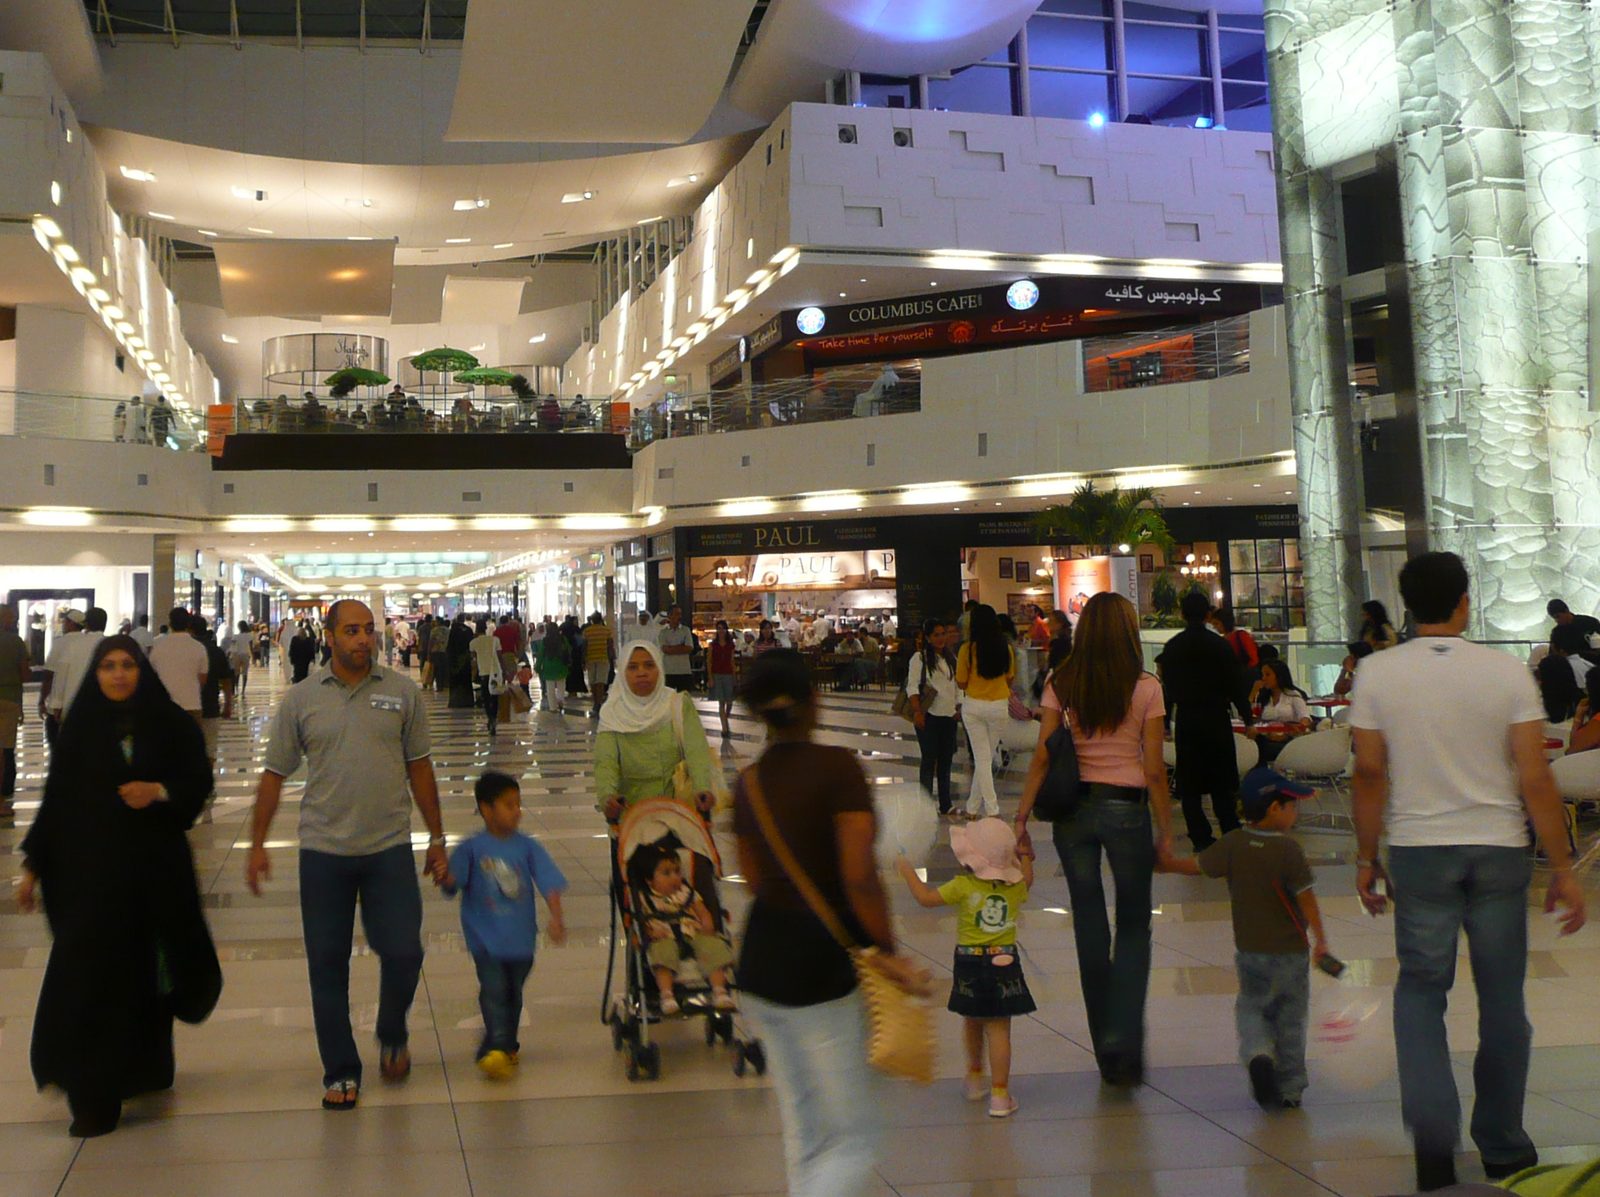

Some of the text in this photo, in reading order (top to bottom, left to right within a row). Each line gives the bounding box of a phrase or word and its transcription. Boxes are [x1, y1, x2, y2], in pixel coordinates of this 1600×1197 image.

[1105, 285, 1222, 305] كولومبوس كافيه
[849, 300, 934, 323] COLUMBUS
[818, 335, 845, 350] Take
[848, 332, 871, 347] time
[874, 330, 890, 345] for
[892, 328, 934, 344] yourself
[754, 525, 821, 548] PAUL
[779, 555, 841, 575] PAUL
